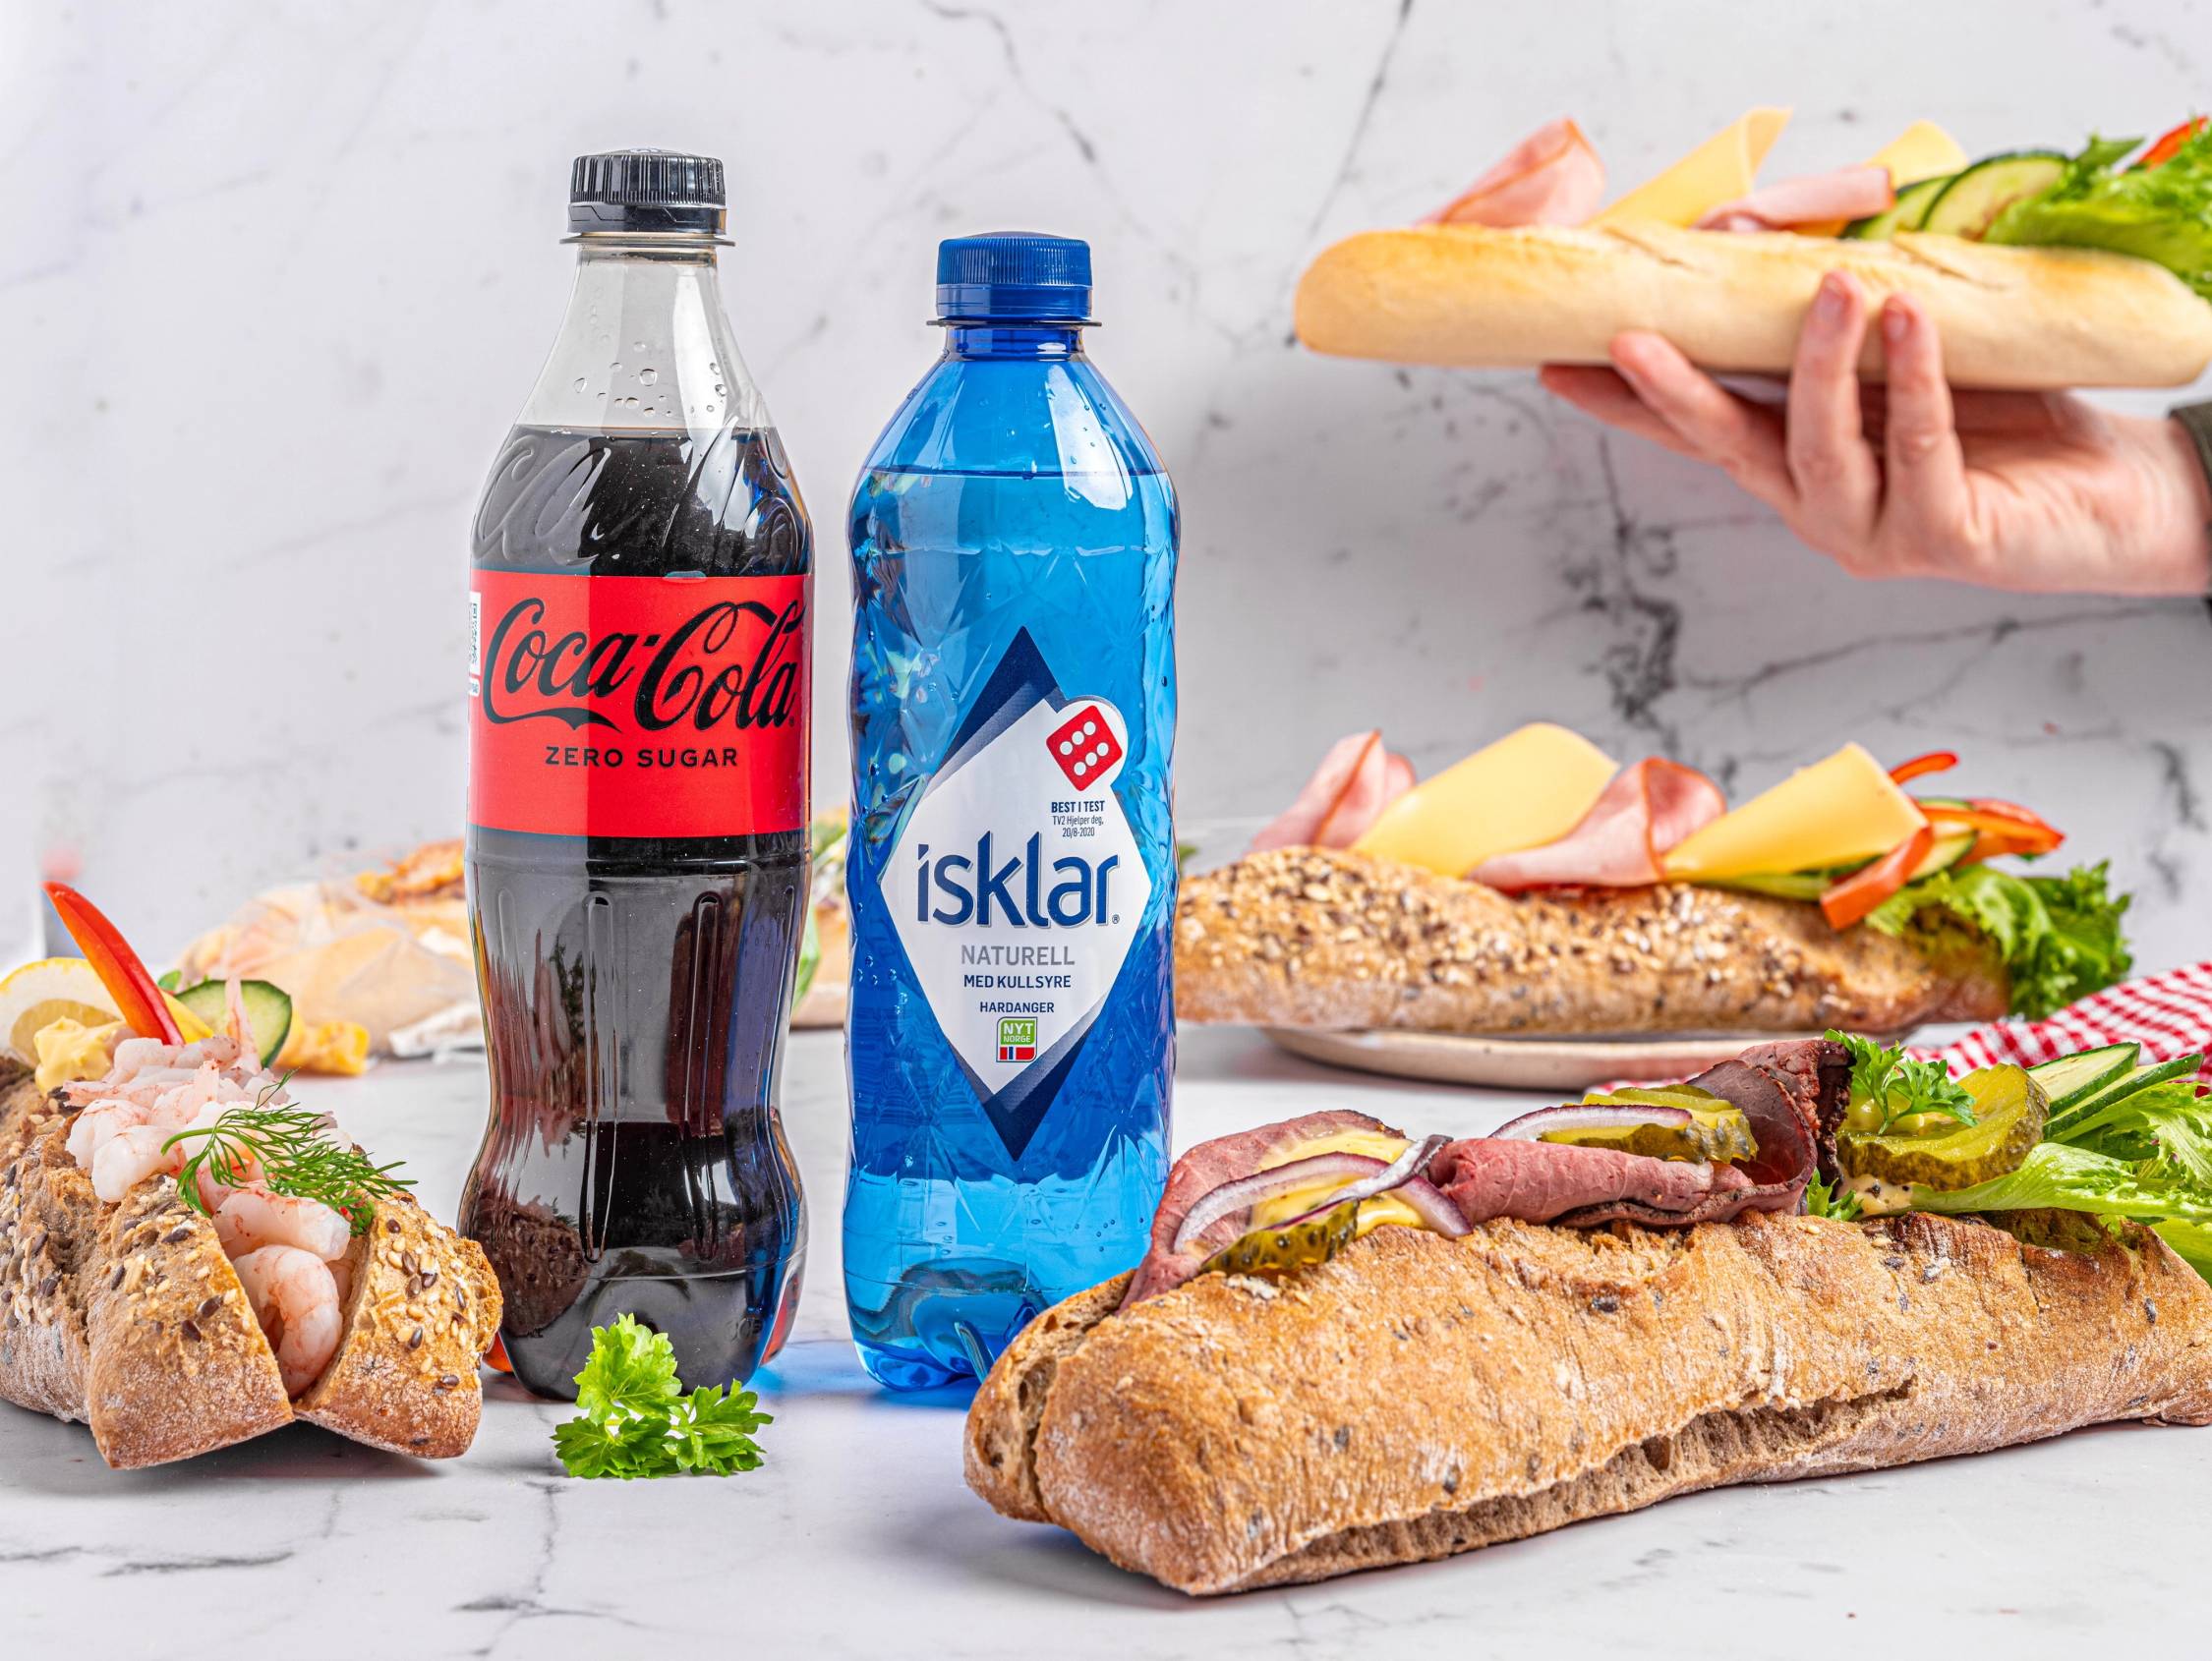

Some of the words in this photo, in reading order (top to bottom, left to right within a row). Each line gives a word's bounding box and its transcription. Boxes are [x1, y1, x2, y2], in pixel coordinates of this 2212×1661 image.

[483, 598, 807, 733] Coca-Cola
[545, 745, 623, 768] ZERO
[637, 747, 738, 768] SUGAR
[1051, 801, 1076, 813] BEST
[1077, 801, 1081, 813] I
[1083, 800, 1105, 812] TEST
[1052, 815, 1066, 826] TV2
[1067, 815, 1090, 827] Hjelper
[1062, 827, 1095, 838] 20/8-2020
[917, 830, 1119, 927] isklar
[960, 945, 1075, 966] NATURELL
[963, 974, 994, 989] MED
[997, 974, 1071, 989] KULLSYRE
[979, 1002, 1054, 1013] HARDANGER
[1004, 1022, 1033, 1035] NYT
